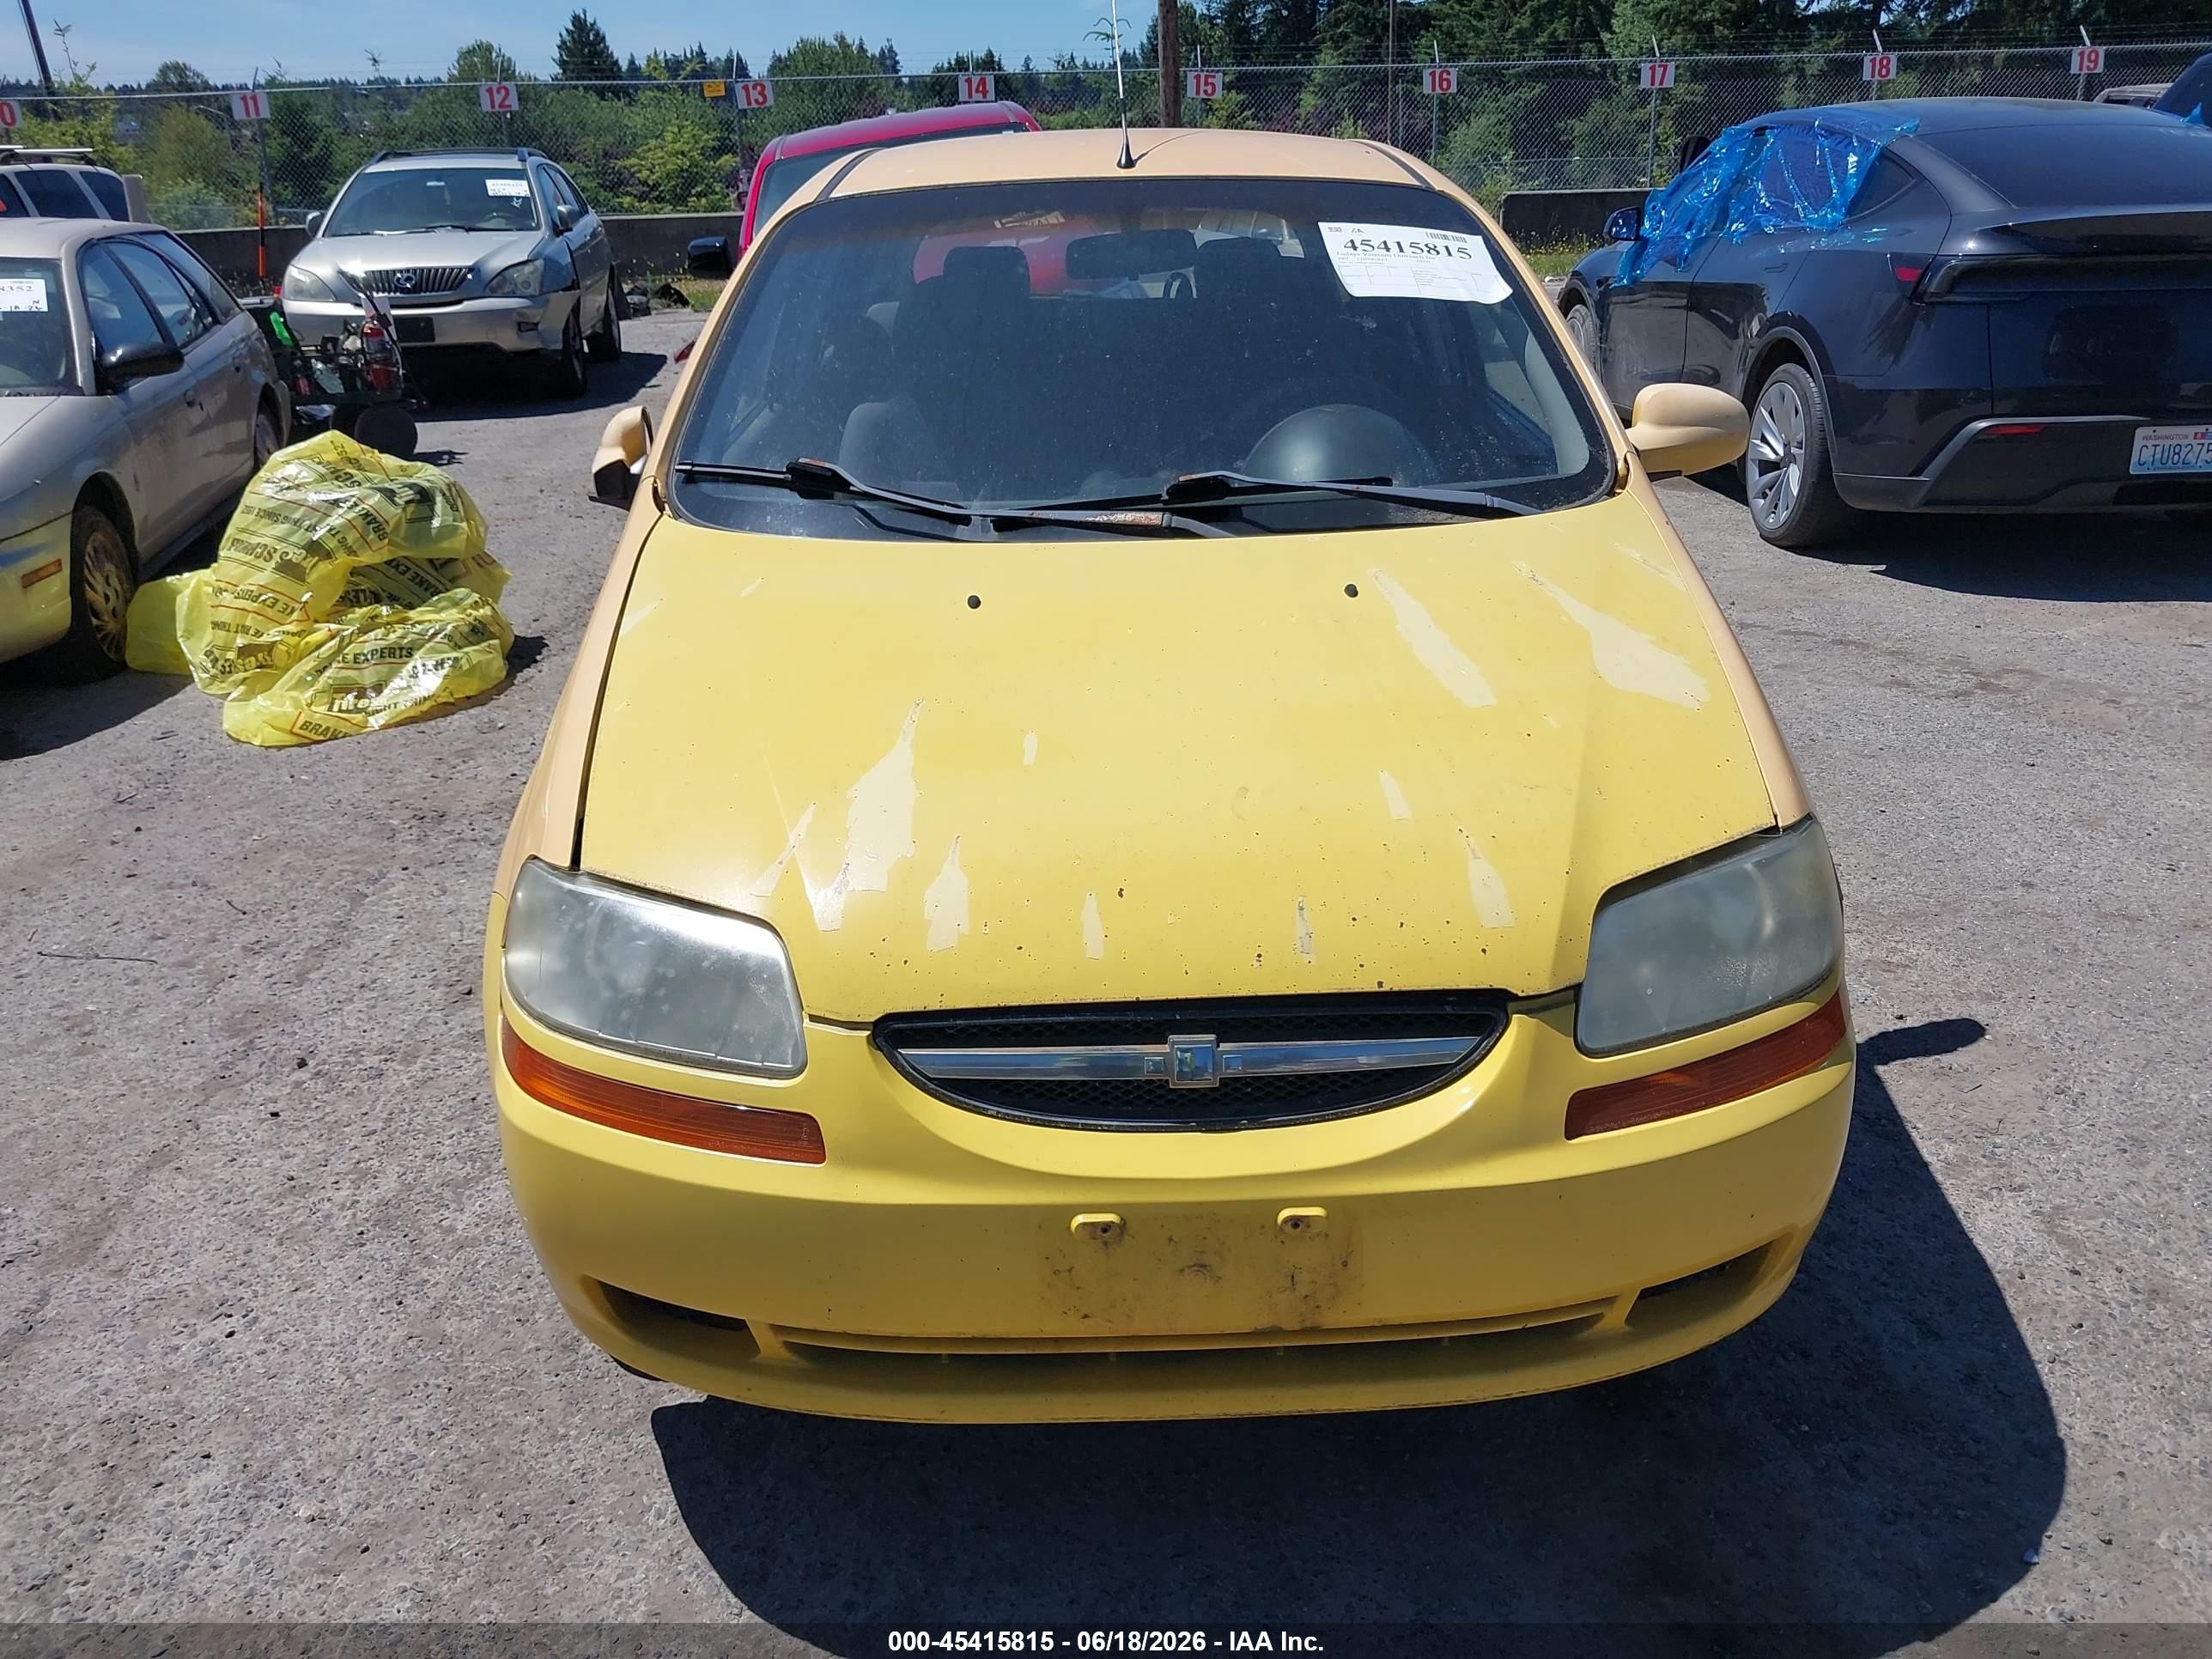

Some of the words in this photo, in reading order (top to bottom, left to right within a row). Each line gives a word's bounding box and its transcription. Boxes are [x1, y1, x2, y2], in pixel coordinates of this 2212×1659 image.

[1869, 55, 1891, 78] 18
[2077, 49, 2100, 71] 19
[1194, 73, 1217, 97] 15
[1428, 69, 1451, 92] 16
[1648, 64, 1669, 87] 17
[485, 86, 512, 110] 12
[741, 82, 768, 107] 13
[964, 76, 989, 100] 14
[240, 94, 262, 118] 11
[1343, 239, 1473, 260] 45415815
[2142, 433, 2190, 441] WASHINGTON
[352, 647, 414, 665] EXPERTS
